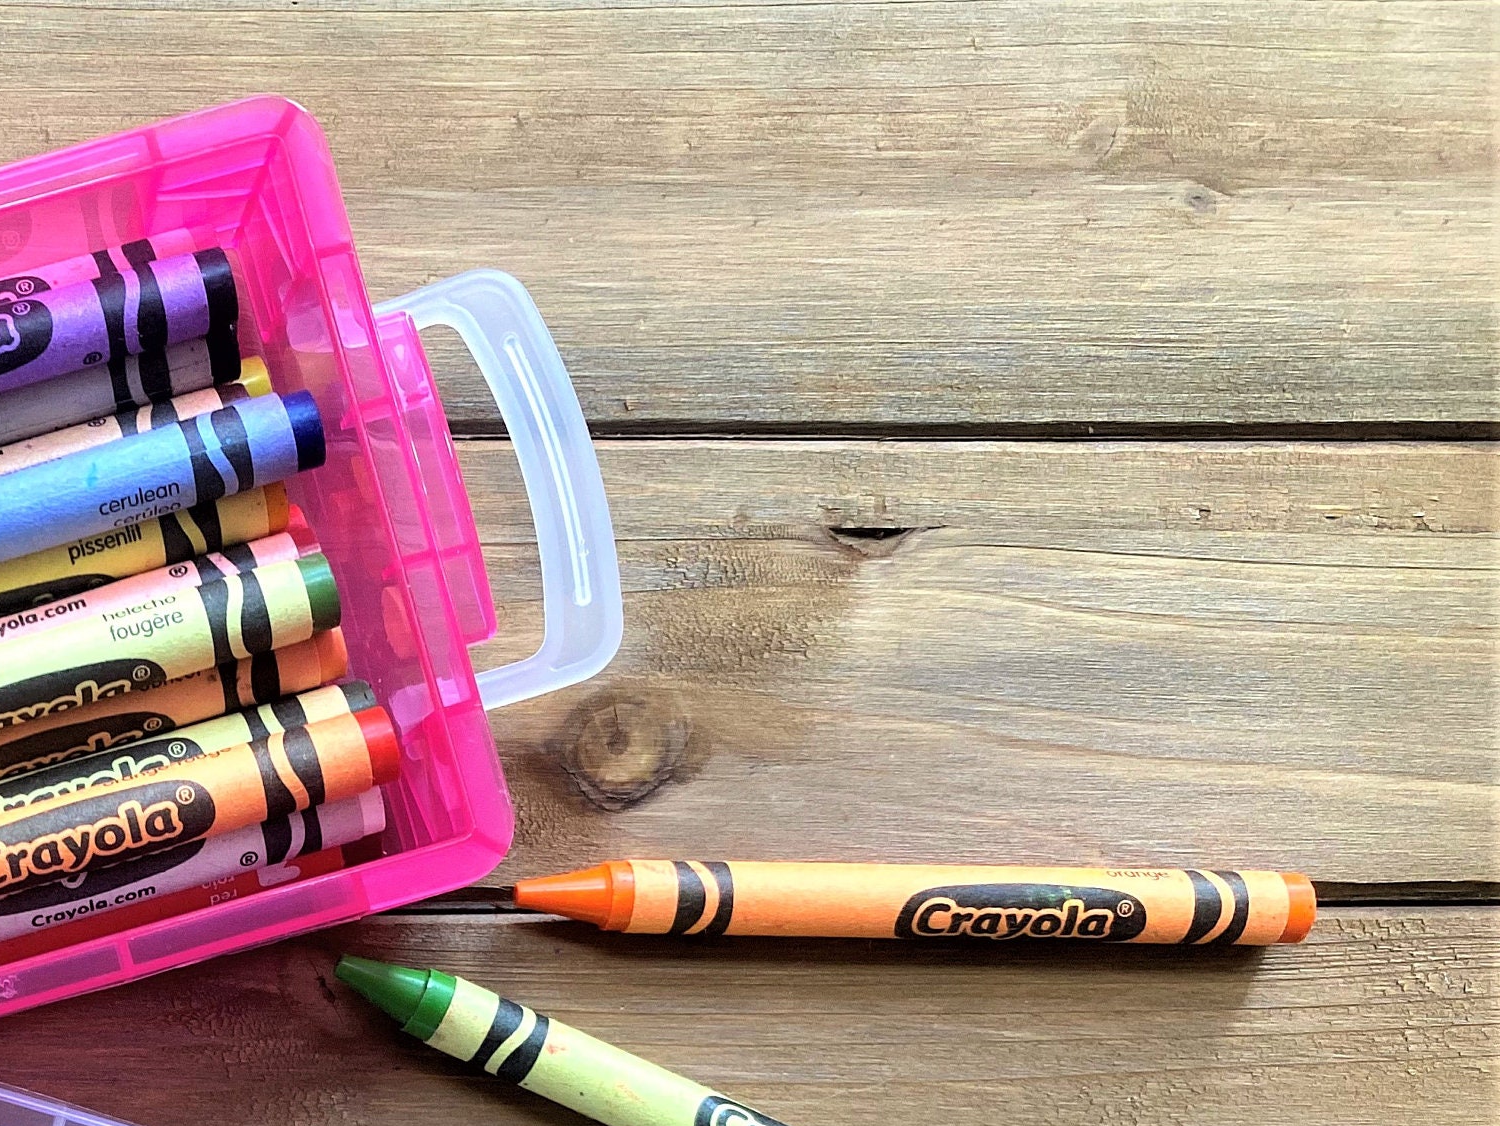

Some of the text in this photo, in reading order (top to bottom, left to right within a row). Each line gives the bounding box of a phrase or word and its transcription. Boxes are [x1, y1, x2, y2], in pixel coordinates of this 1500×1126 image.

[99, 482, 180, 516] cerulean
[102, 595, 176, 623] helecho
[109, 611, 184, 642] fougère
[31, 885, 157, 927] Crayola.com
[911, 896, 1113, 940] Crayola
